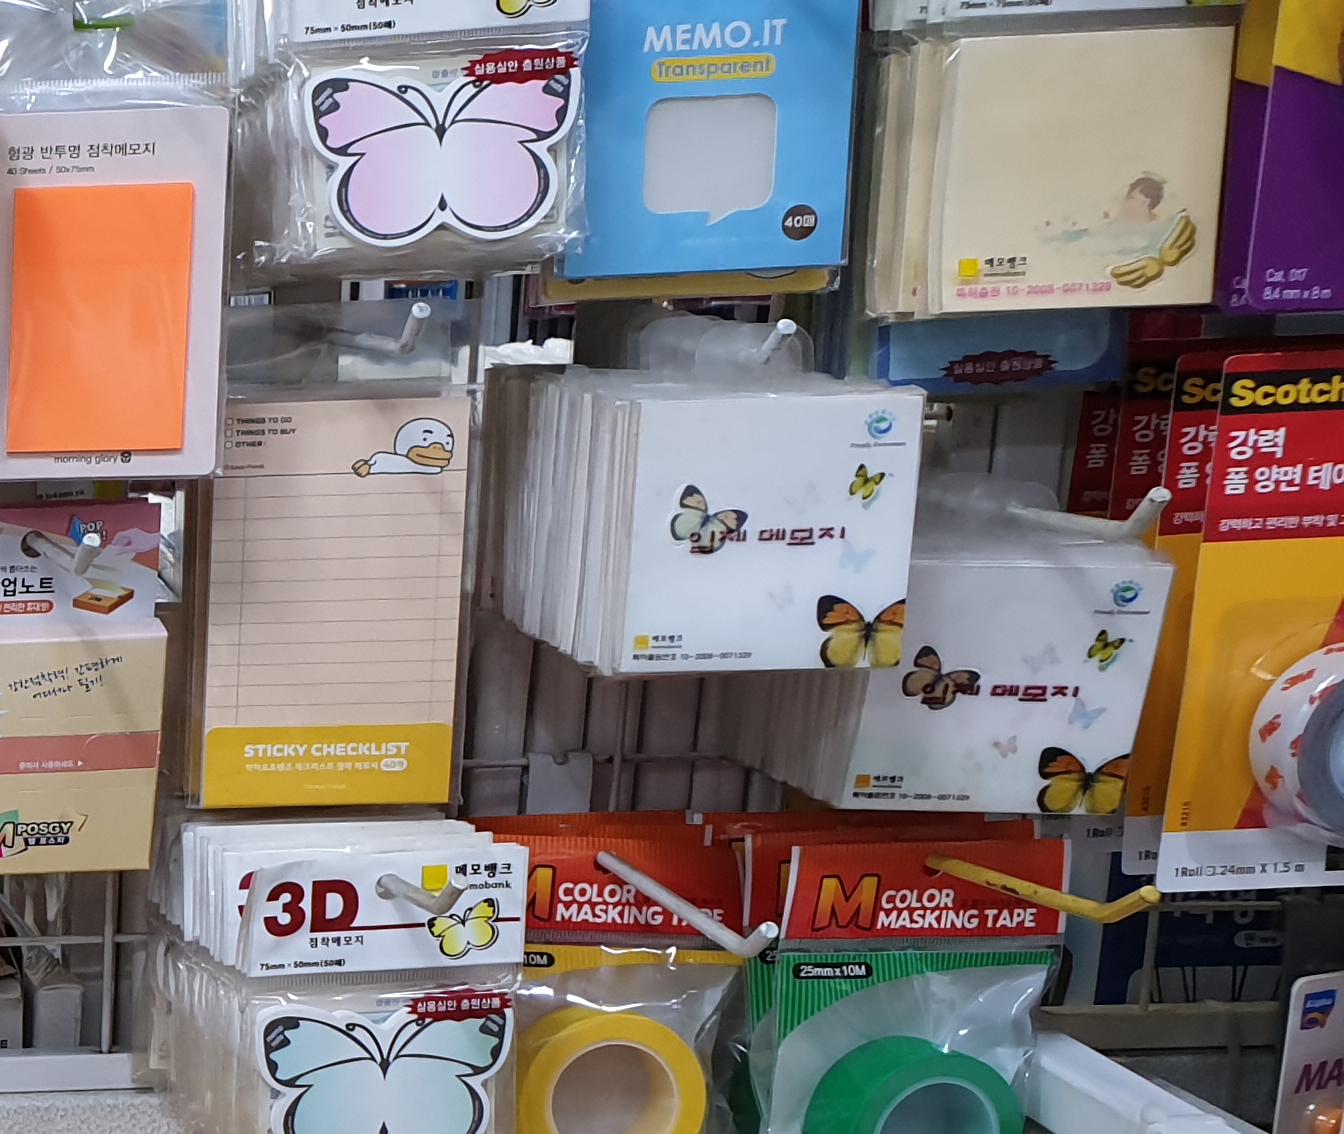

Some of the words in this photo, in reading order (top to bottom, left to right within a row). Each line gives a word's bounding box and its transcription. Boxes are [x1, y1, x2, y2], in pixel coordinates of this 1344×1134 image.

[642, 20, 787, 52] MEMO.IT
[656, 57, 772, 78] Transparent
[1230, 375, 1344, 407] Scotch
[1227, 427, 1286, 460] 강력
[54, 454, 92, 465] morning
[95, 454, 118, 465] glory
[1223, 467, 1249, 494] 폼
[1254, 464, 1303, 493] 양면
[80, 521, 103, 533] POP
[244, 743, 308, 758] STICKY
[311, 742, 409, 757] CHECKLIST
[263, 879, 359, 937] 3D
[814, 874, 879, 930] M
[883, 889, 954, 909] COLOR
[877, 910, 983, 930] MASKING
[986, 908, 1036, 928] TAPE
